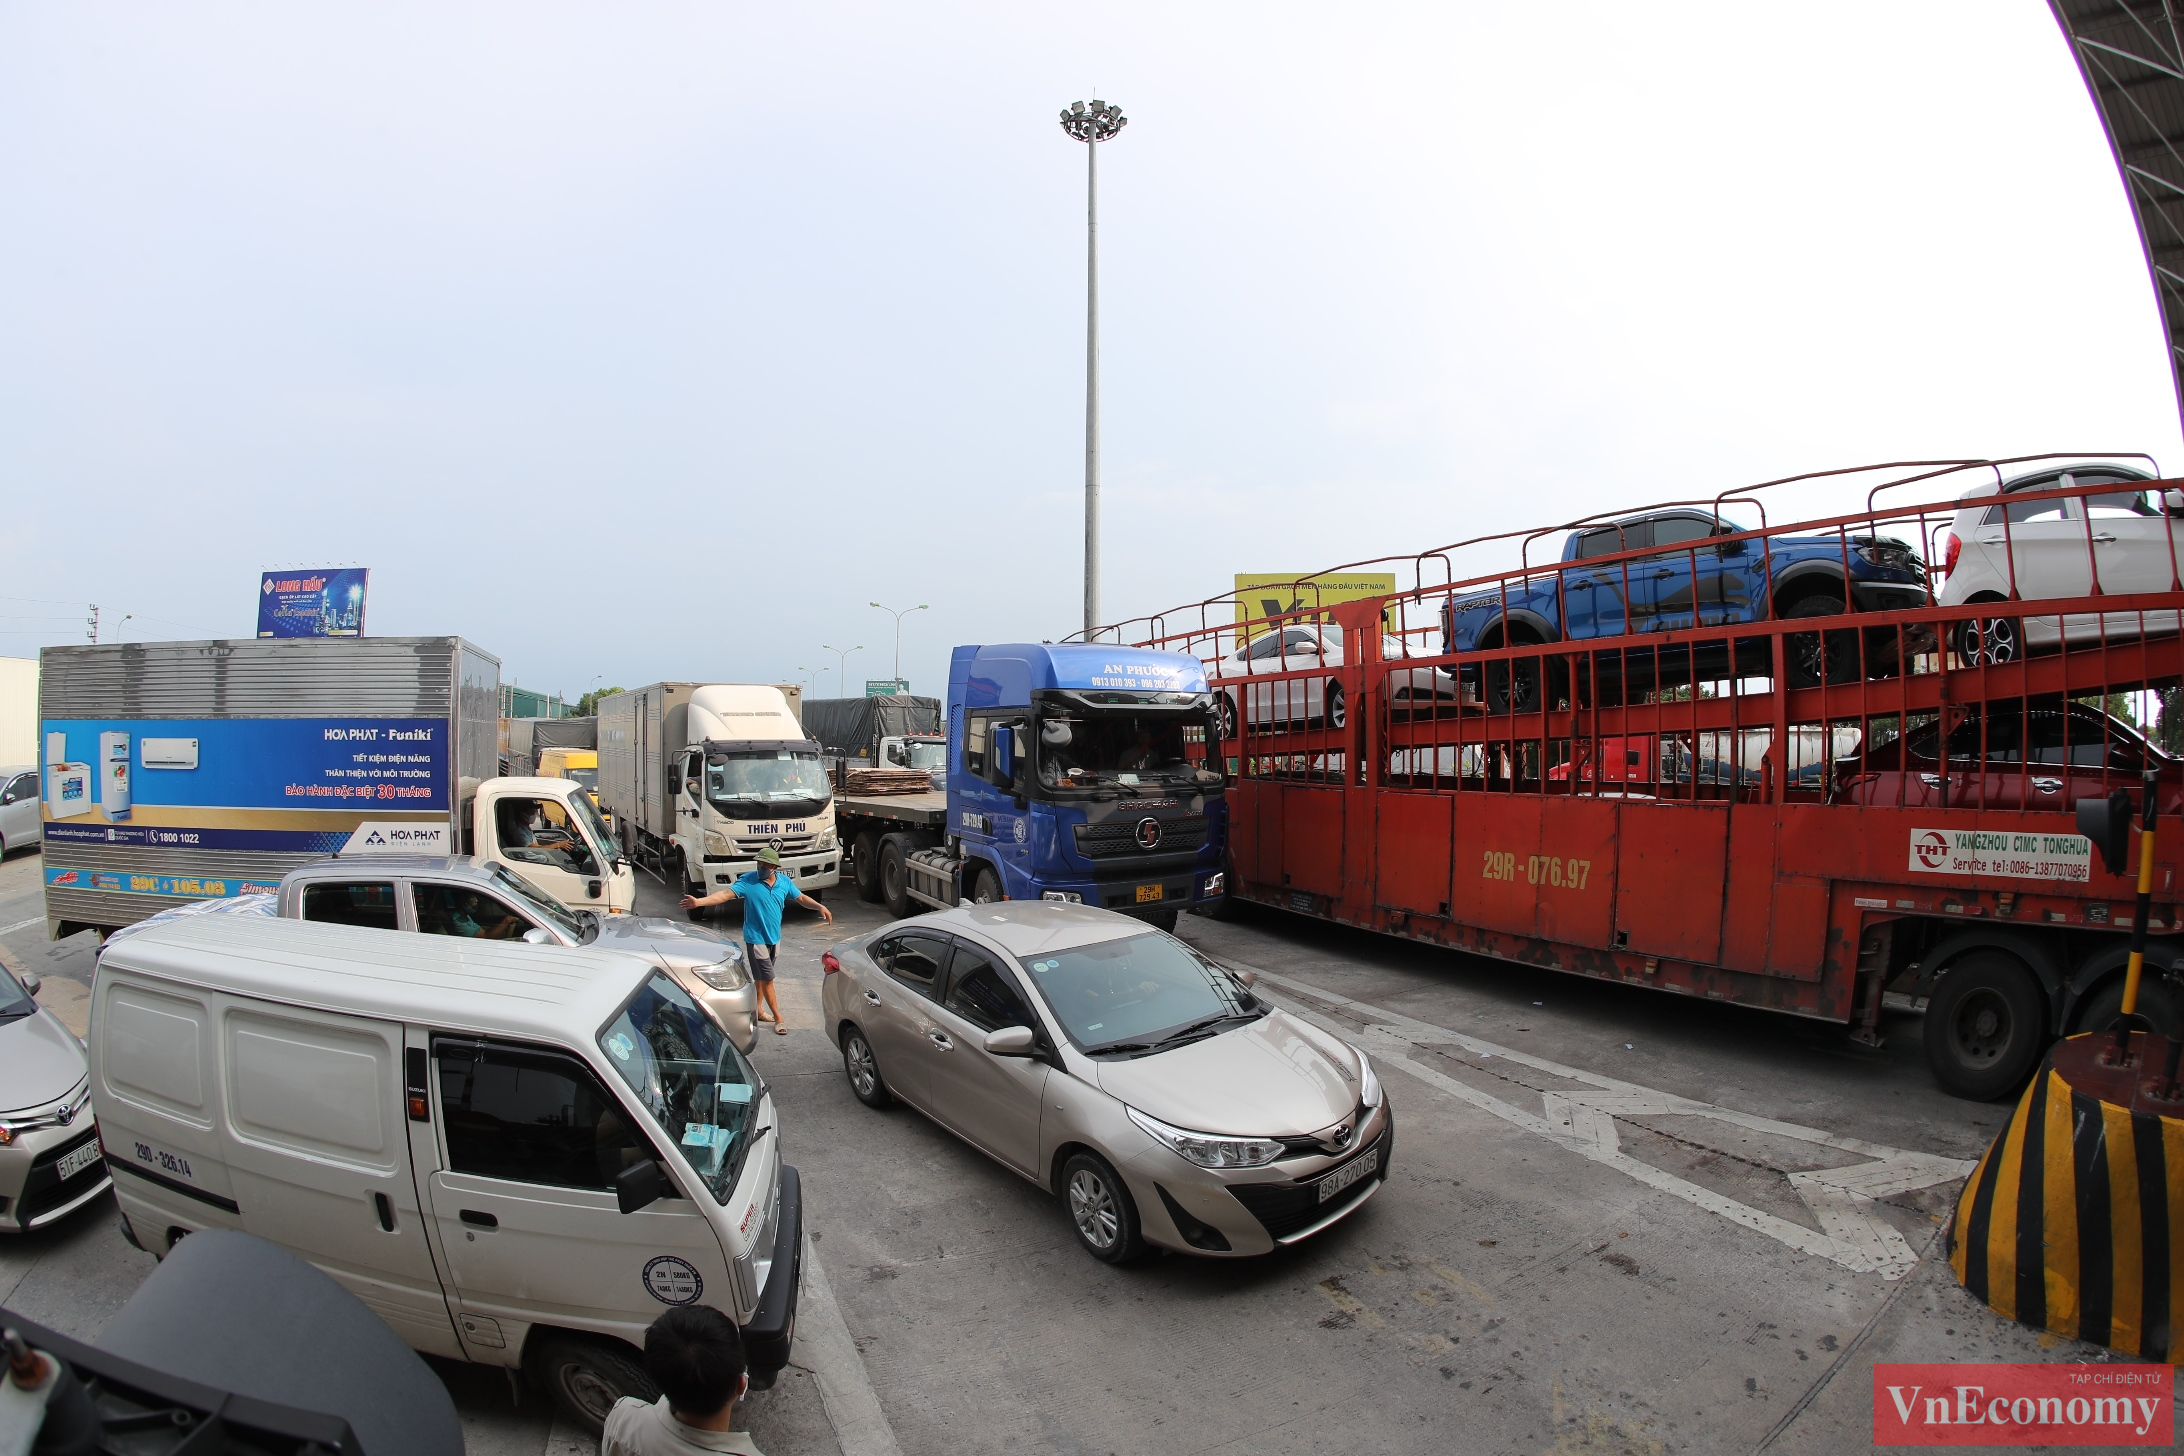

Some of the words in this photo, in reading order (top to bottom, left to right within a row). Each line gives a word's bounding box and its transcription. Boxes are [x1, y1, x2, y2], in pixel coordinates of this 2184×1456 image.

[276, 580, 300, 593] LONG
[1319, 582, 1338, 590] HÀNG
[1354, 582, 1369, 592] VIỆT
[1456, 596, 1502, 613] RAPTOR
[1103, 664, 1123, 674] AN
[388, 728, 431, 741] Funiki
[353, 753, 368, 763] TIẾT
[368, 754, 387, 764] KIỆM
[388, 754, 407, 765] ĐIỆN
[346, 769, 367, 779] THIỆN
[368, 768, 382, 777] VỚI
[383, 768, 398, 777] MÔI
[285, 783, 305, 796] BẢO
[306, 784, 333, 797] HÀNH
[333, 784, 354, 799] ĐẶC
[355, 784, 377, 800] BIỆT
[377, 784, 395, 799] 30
[396, 785, 431, 798] THÁNG
[1119, 799, 1179, 811] SHACMAN
[747, 821, 779, 835] THIÊN
[785, 820, 806, 834] PHÚ
[159, 833, 178, 842] 1800
[180, 833, 200, 843] 1022
[1955, 833, 2008, 851] YANGZHOU
[2043, 837, 2089, 856] TONGHUA
[1482, 850, 1515, 882] 29R
[1527, 855, 1591, 890] 076.97
[1952, 857, 1987, 872] Service
[135, 1141, 153, 1163] 29D
[159, 1150, 192, 1178] 326.14
[1321, 1153, 1377, 1200] 98A-270.05
